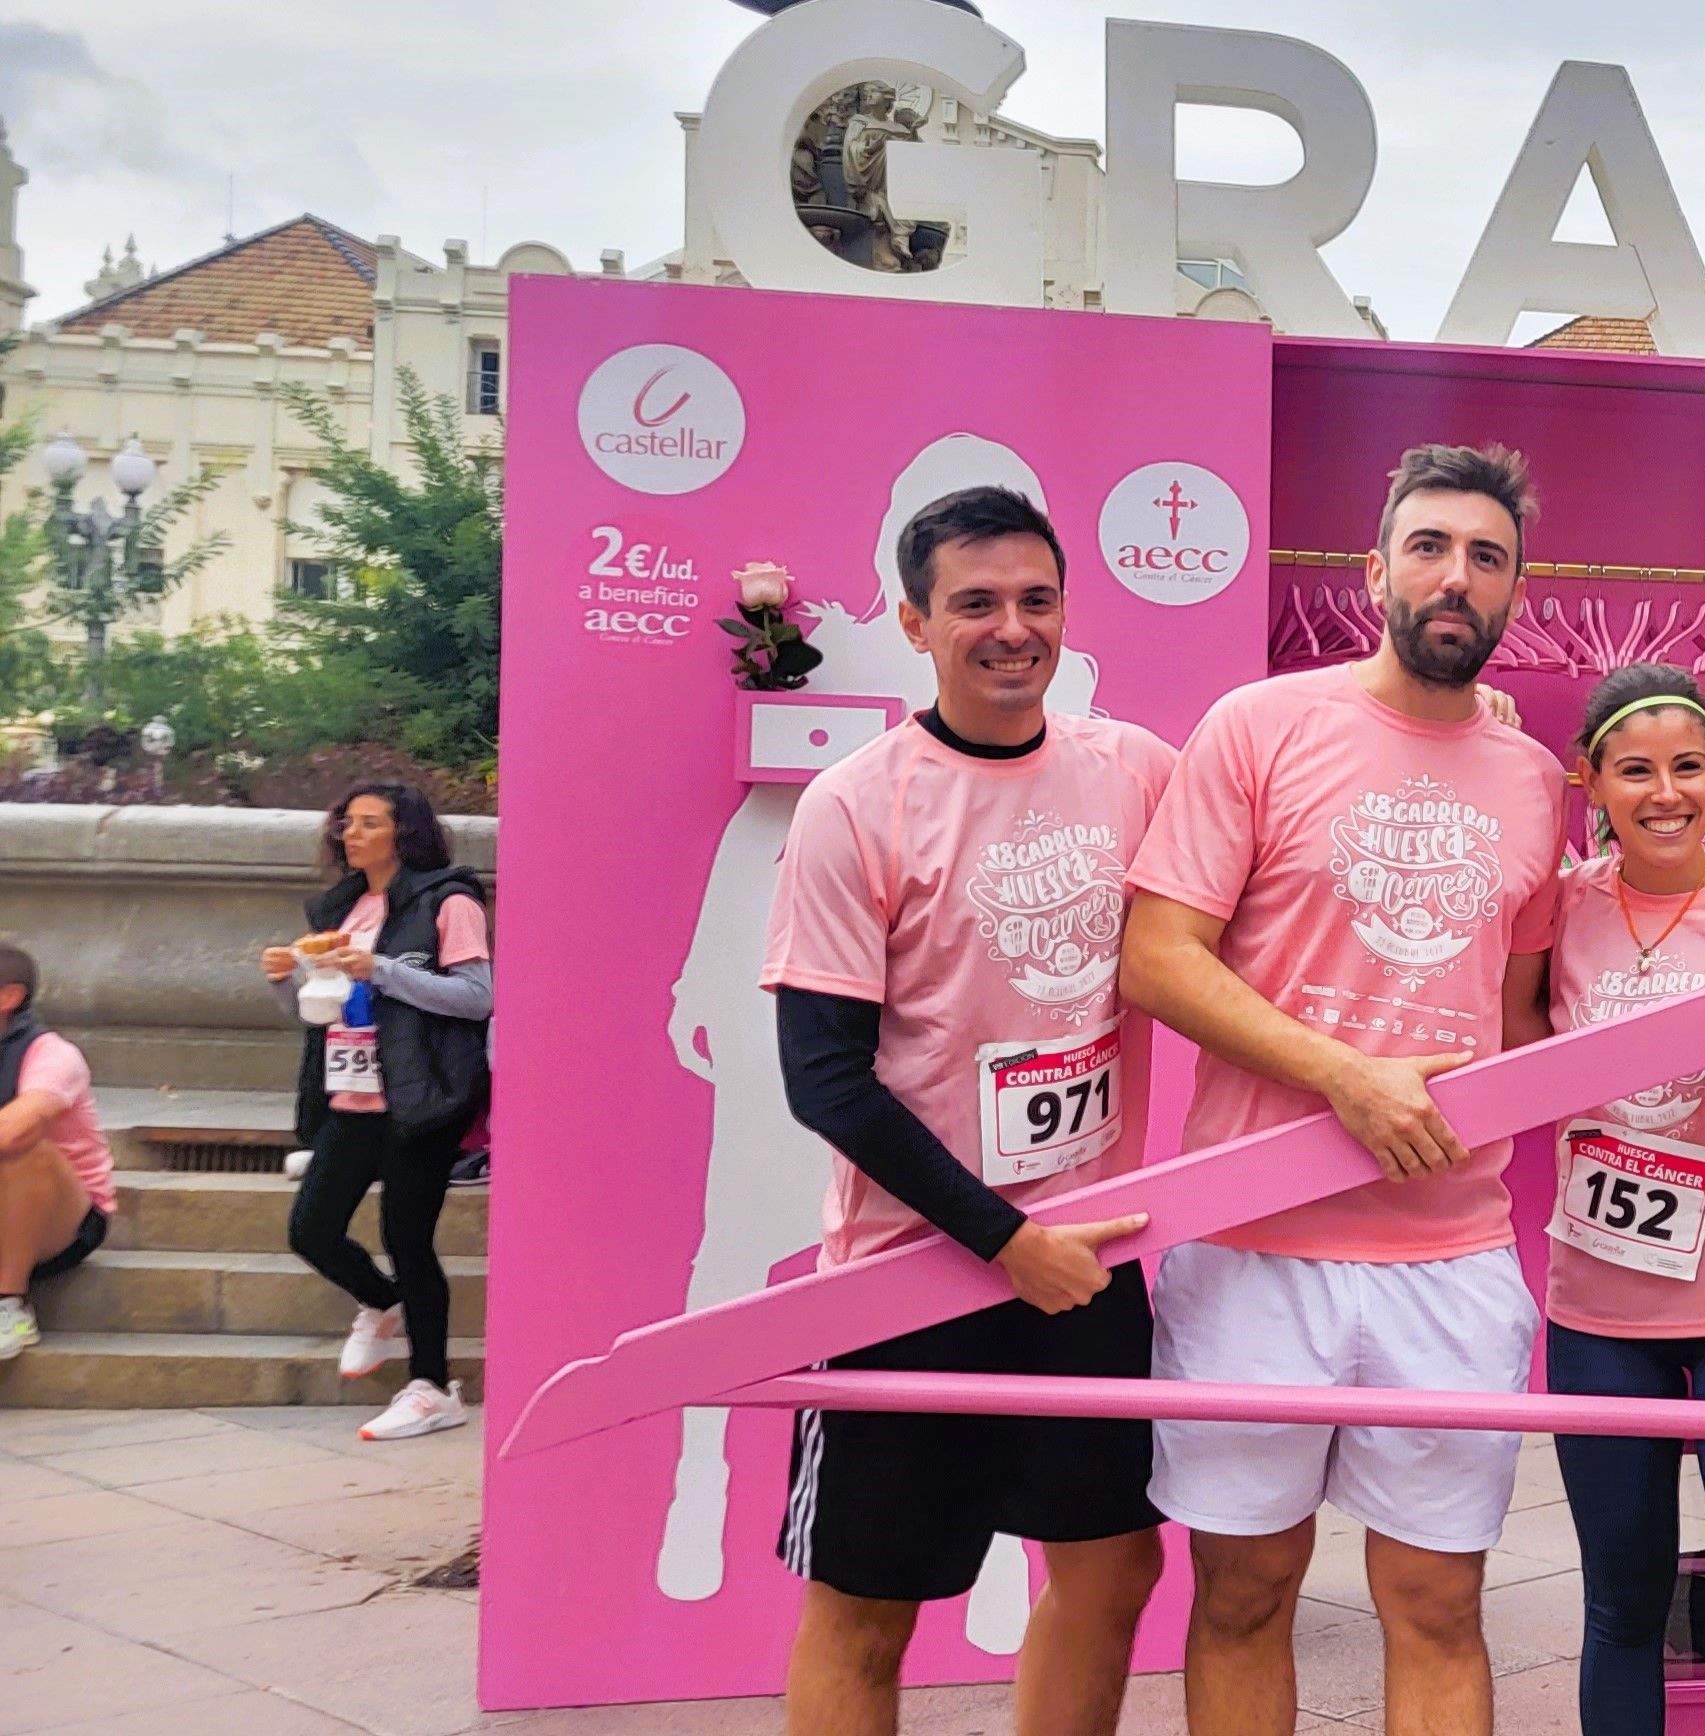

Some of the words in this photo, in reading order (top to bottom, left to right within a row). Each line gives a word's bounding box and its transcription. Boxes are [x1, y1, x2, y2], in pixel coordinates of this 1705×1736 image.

[595, 427, 728, 461] castellar
[588, 526, 699, 581] 2€/ud.
[1118, 545, 1228, 573] aecc
[579, 585, 592, 599] a
[599, 582, 699, 608] beneficio
[584, 609, 690, 637] aecc
[1063, 1045, 1096, 1064] HUESCA
[1006, 1067, 1073, 1085] CONTRA
[1076, 1062, 1088, 1074] EL
[1027, 1069, 1110, 1144] 971
[1578, 1142, 1624, 1169] CONTRA
[1625, 1161, 1642, 1176] EL
[1644, 1161, 1705, 1188] CÁNCER
[1617, 1143, 1657, 1162] HUESCA
[1586, 1170, 1679, 1241] 152
